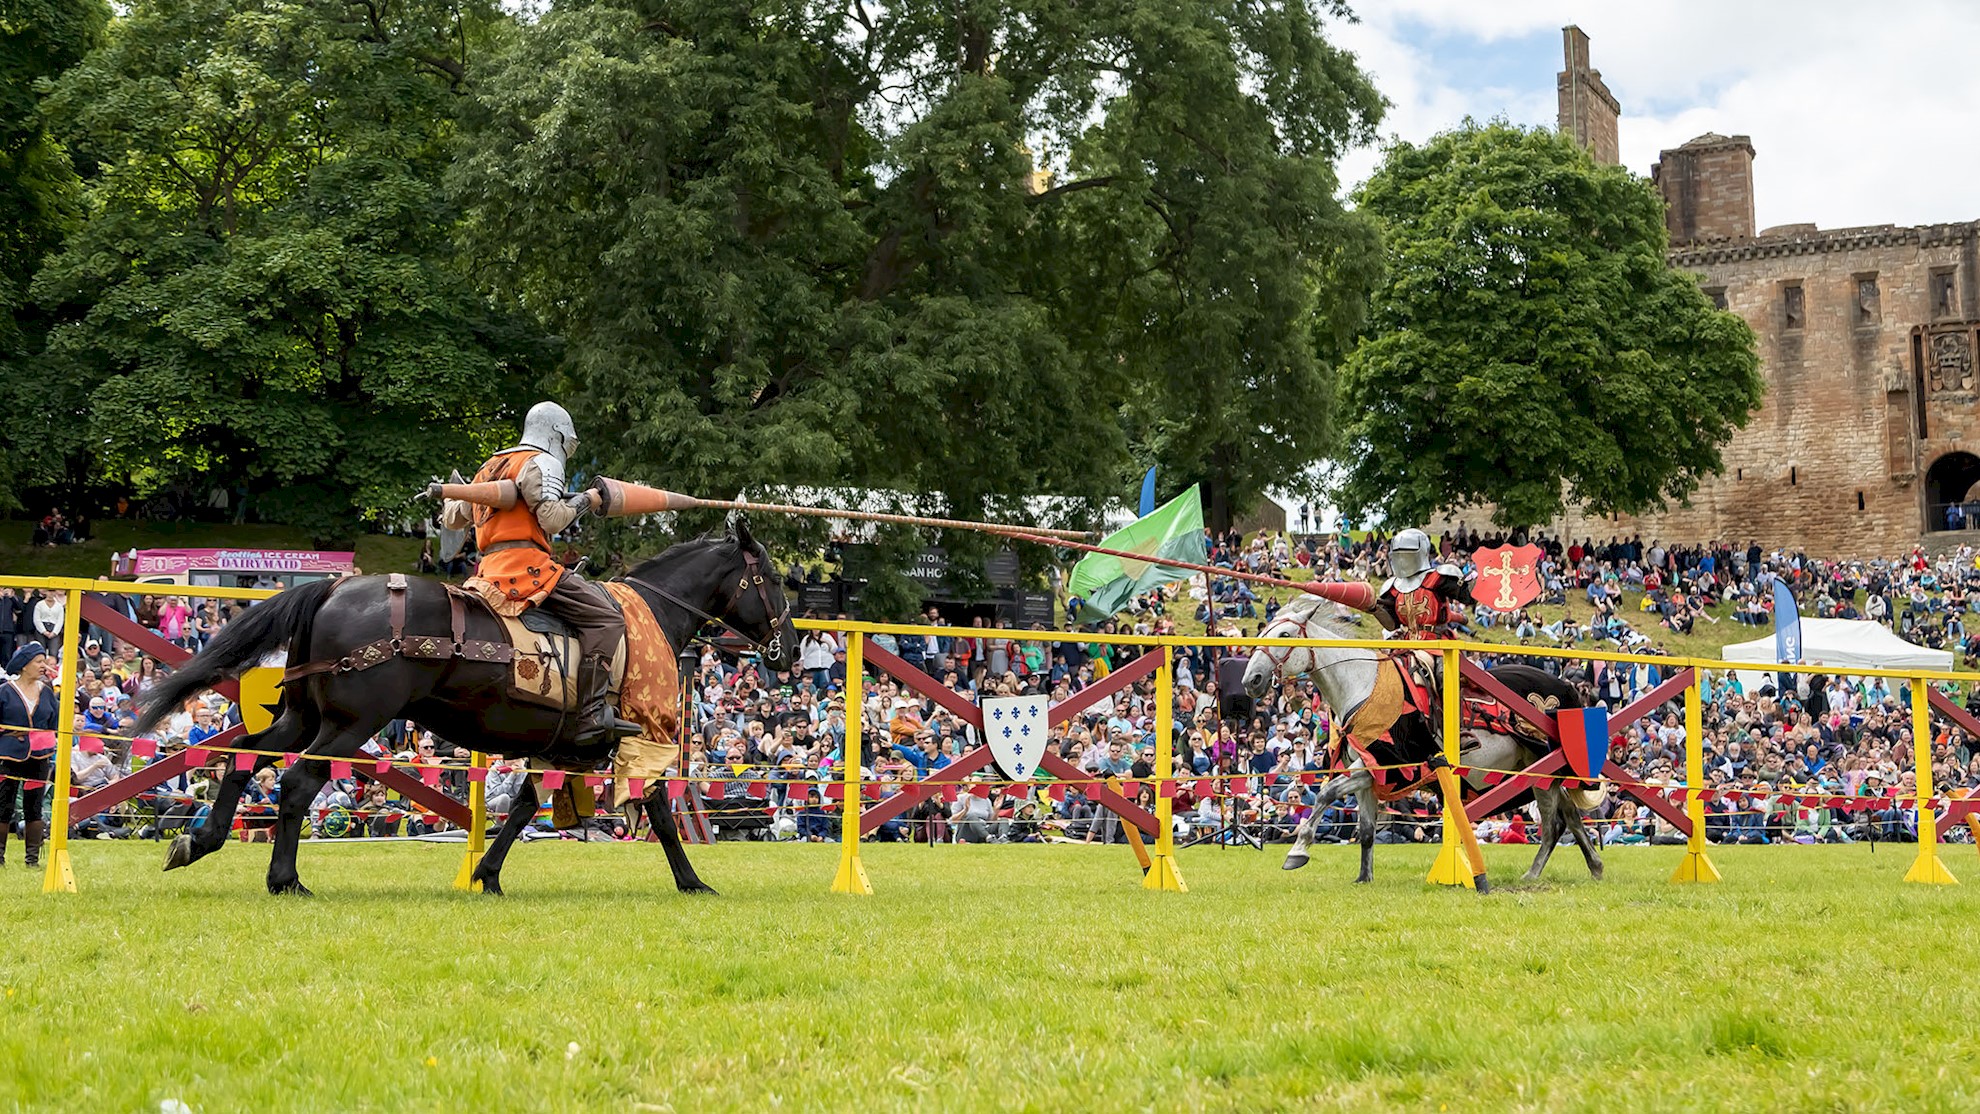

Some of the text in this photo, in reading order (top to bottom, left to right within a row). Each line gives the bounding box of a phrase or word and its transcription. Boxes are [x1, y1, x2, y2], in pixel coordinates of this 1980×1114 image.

[220, 550, 320, 560] Scottish ICE CREAM
[222, 559, 298, 569] DAIRYMAID
